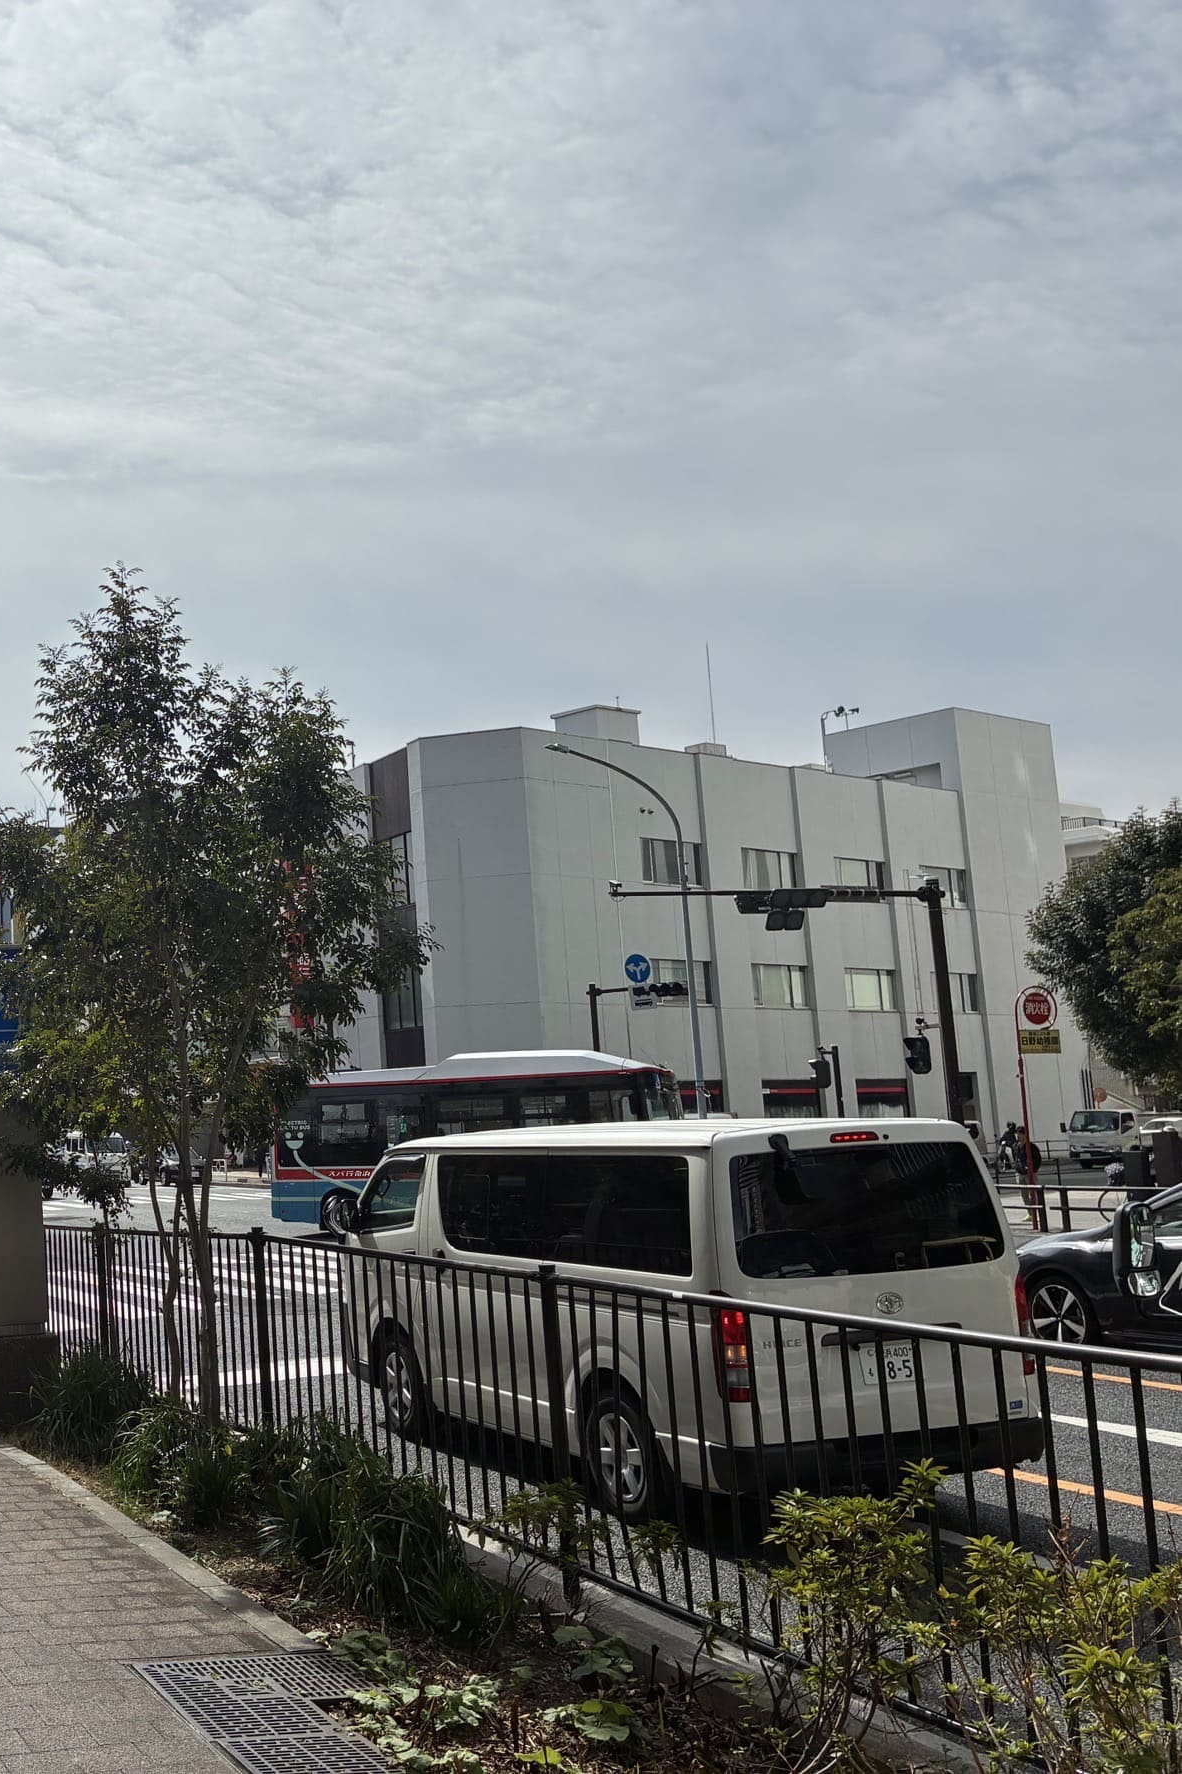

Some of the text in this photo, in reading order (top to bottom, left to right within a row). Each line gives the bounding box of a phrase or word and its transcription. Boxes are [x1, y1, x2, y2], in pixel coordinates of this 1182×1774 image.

[1025, 1001, 1049, 1015] 消火栓
[762, 1338, 803, 1350] HCE
[893, 1346, 909, 1358] 400
